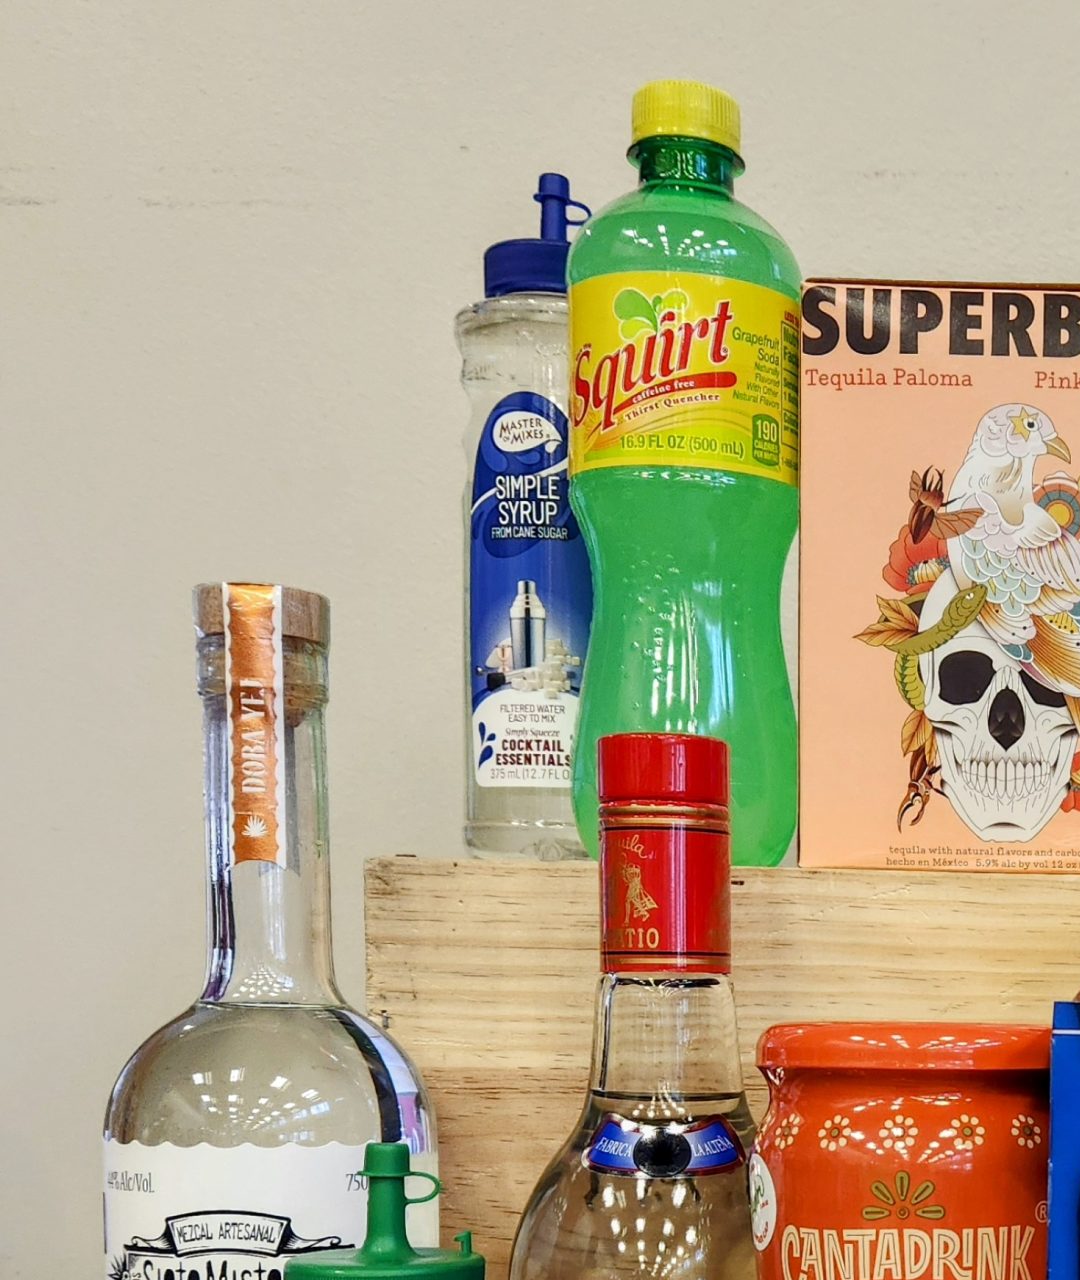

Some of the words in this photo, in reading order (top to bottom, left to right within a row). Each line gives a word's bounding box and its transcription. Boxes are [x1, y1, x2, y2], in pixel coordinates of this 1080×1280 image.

[732, 327, 780, 351] Grapefruit
[573, 302, 732, 431] Squirt
[758, 349, 780, 367] Soda
[632, 385, 672, 404] caffeine
[674, 379, 696, 393] free
[805, 369, 886, 392] Tequila
[892, 369, 973, 388] Paloma
[624, 402, 660, 422] Thirst
[664, 393, 721, 408] Quencher
[500, 418, 543, 438] MASTER
[511, 430, 545, 445] MIXES
[756, 420, 778, 442] 190
[620, 436, 647, 449] 16.9
[649, 436, 665, 449] FL
[667, 436, 686, 449] OZ
[689, 437, 718, 453] (500
[720, 440, 744, 458] mL)
[495, 475, 561, 500] SIMPLE
[498, 501, 558, 525] SYRUP
[491, 526, 512, 539] FROM
[513, 526, 537, 538] CANE
[538, 526, 568, 539] SUGAR
[500, 704, 535, 713] FILTERED
[537, 704, 565, 714] WATER
[508, 714, 527, 722] EASY
[541, 714, 556, 723] MIX
[501, 739, 564, 752] COCKTAIL
[496, 753, 571, 766] ESSENTIALS
[889, 846, 926, 857] tequila
[928, 846, 953, 856] with
[955, 846, 994, 856] natural
[996, 847, 1032, 857] flavors
[1034, 848, 1053, 857] and
[886, 857, 916, 867] hecho
[975, 858, 999, 869] 5.9%
[596, 1136, 633, 1158] FABRICA
[177, 1224, 213, 1244] MEZCAL
[218, 1222, 277, 1244] ARTESANAL
